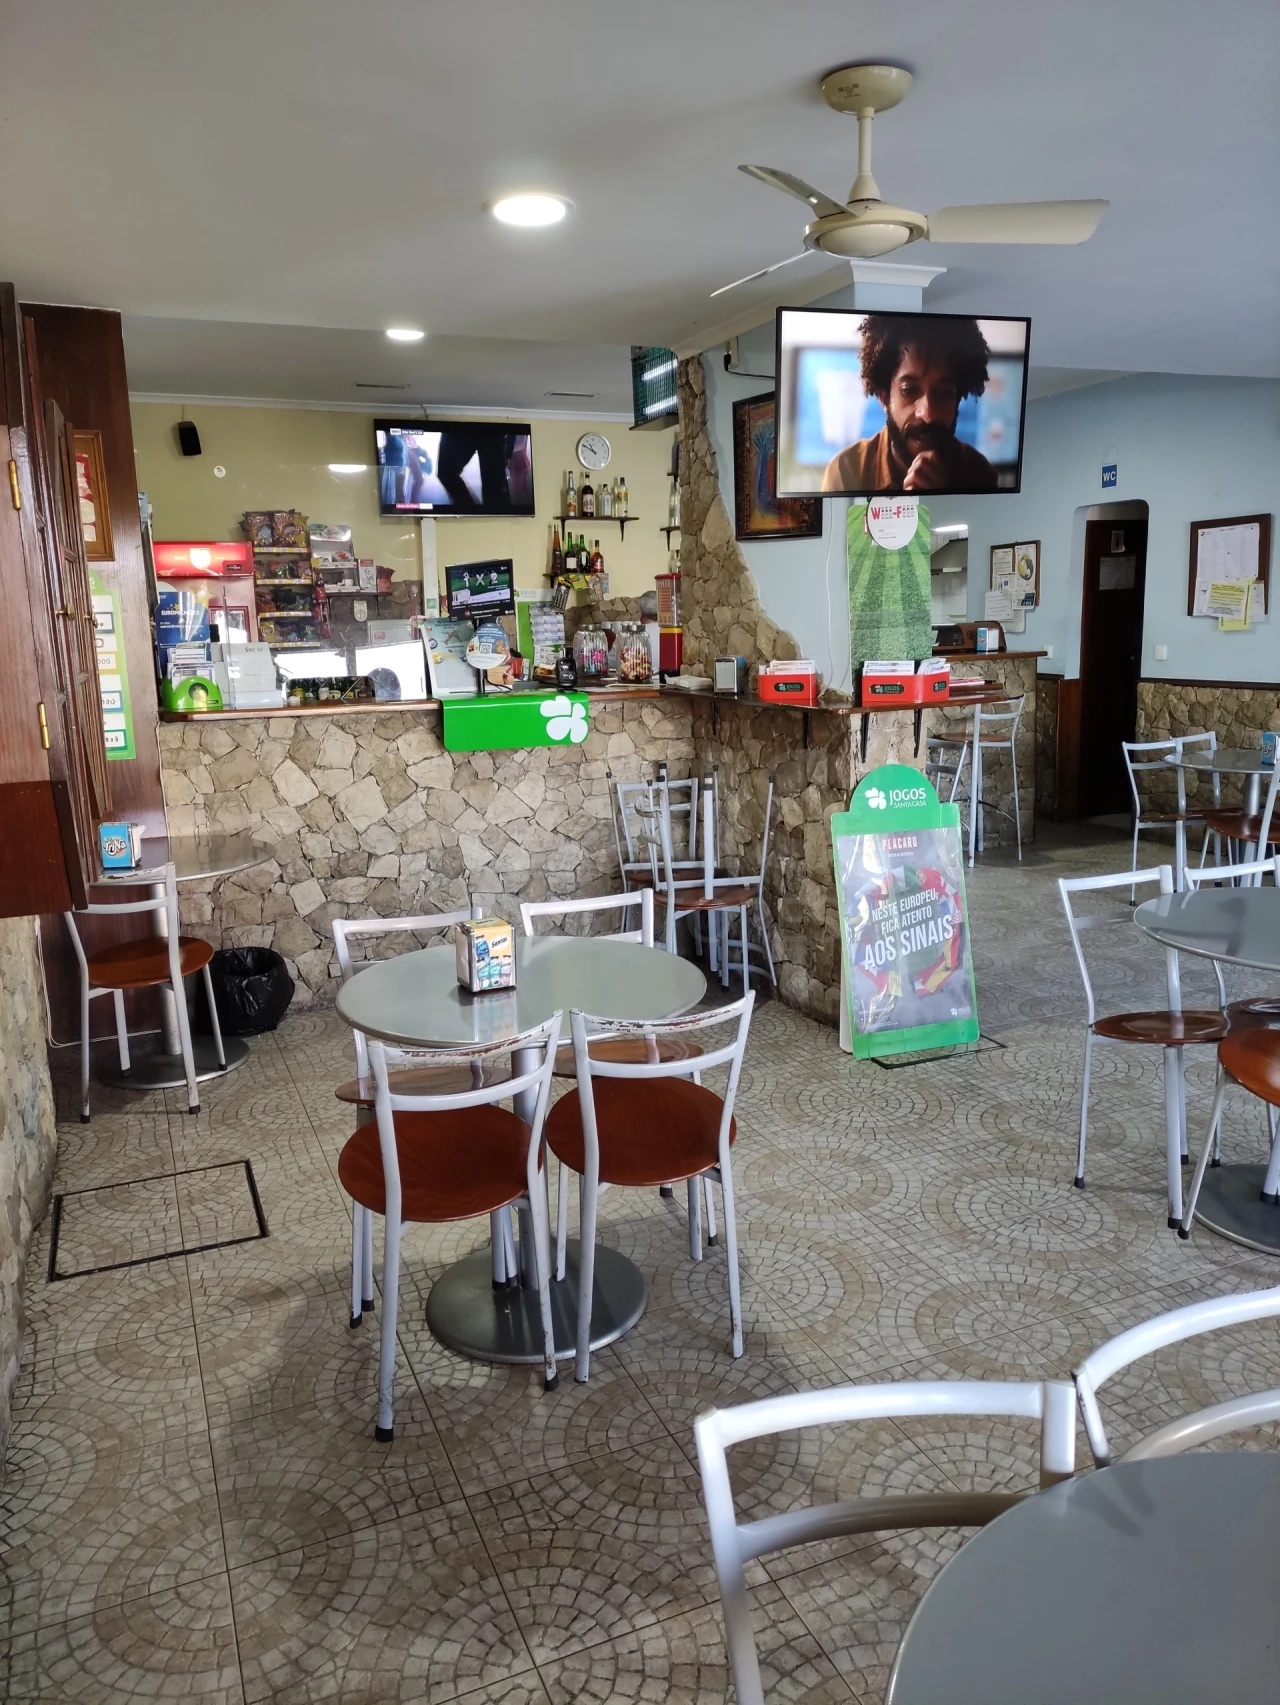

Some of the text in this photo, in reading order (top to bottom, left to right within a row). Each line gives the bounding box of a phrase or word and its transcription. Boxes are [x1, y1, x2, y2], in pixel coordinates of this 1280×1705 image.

[1103, 471, 1116, 482] WC
[520, 590, 536, 598] JOGOS
[786, 683, 801, 691] JOGOS
[884, 685, 900, 693] JOGOS
[889, 787, 927, 806] JOGOS
[882, 836, 918, 851] PLACARD
[871, 887, 939, 923] NESTE EUROPEU,
[881, 905, 932, 935] FICA ATENTO
[491, 936, 508, 949] Santal
[864, 914, 954, 971] AOS SINAIS
